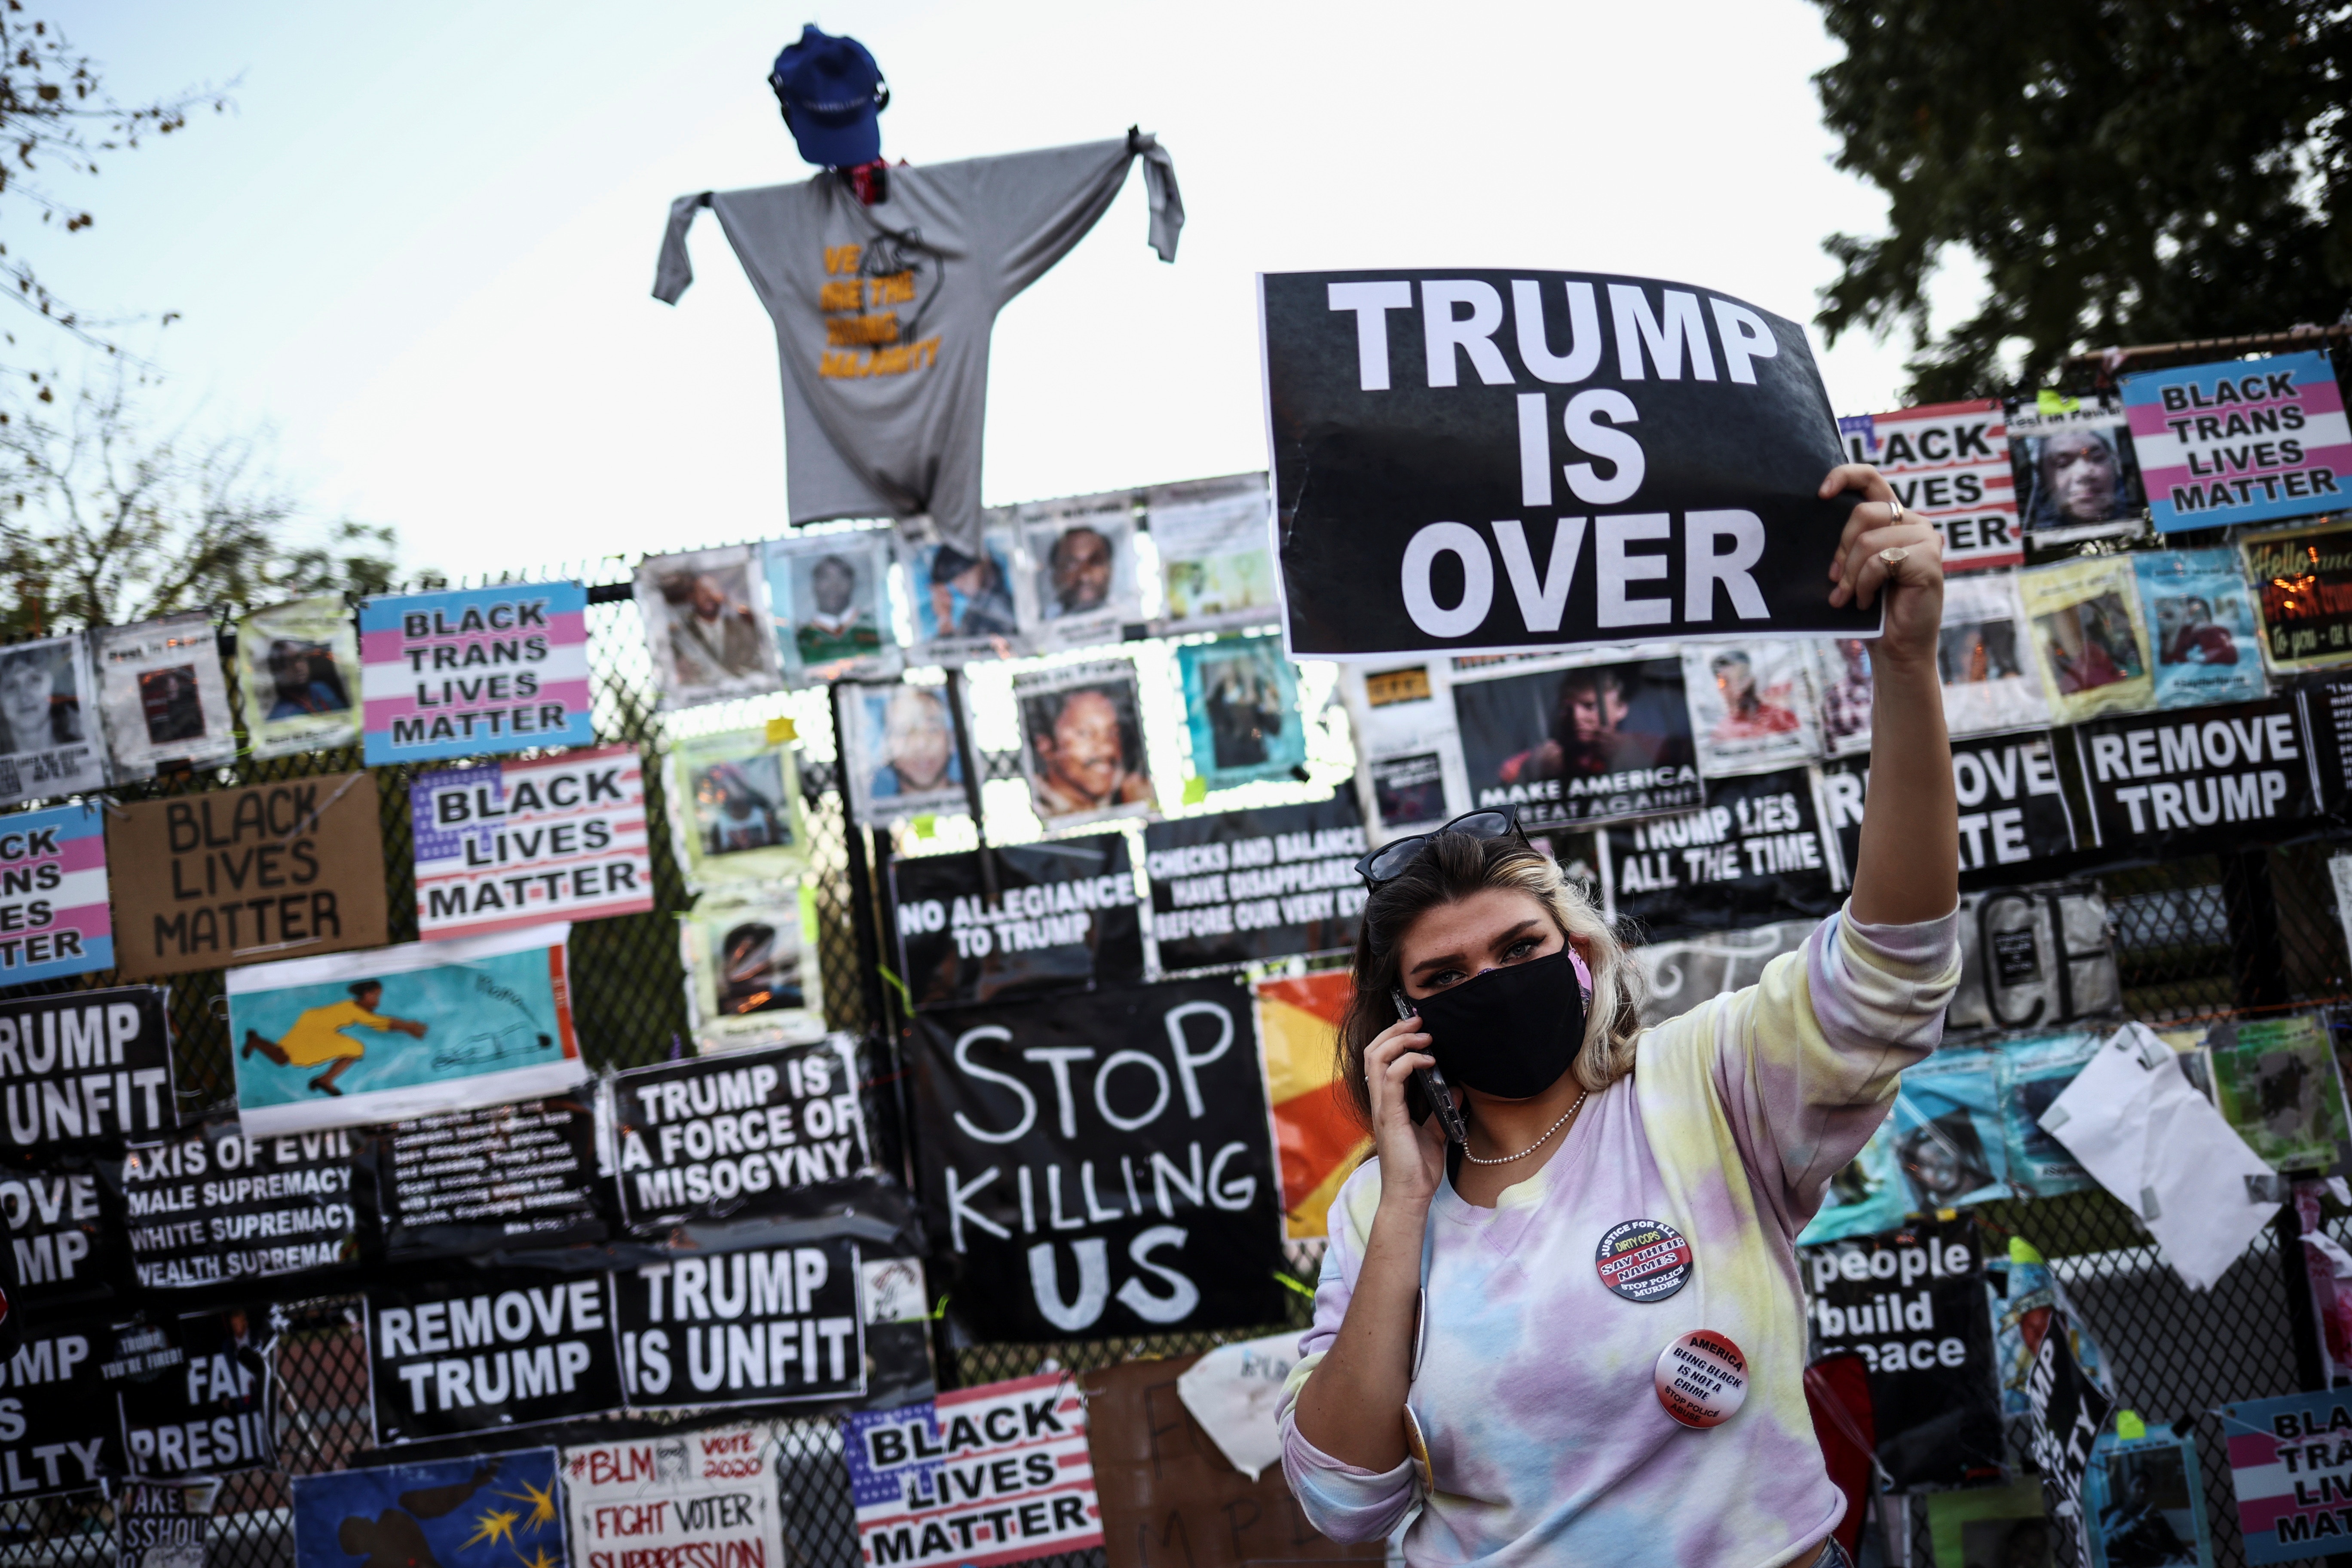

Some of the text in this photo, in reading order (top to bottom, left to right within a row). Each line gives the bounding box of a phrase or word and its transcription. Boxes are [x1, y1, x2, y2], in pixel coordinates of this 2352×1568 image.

[1328, 279, 1777, 391] TRUMP
[2162, 372, 2297, 411] BLACK
[1517, 389, 1645, 506] IS
[1851, 424, 1991, 466] LACK
[2168, 405, 2305, 443] TRANS
[2188, 439, 2303, 476] LIVES
[1893, 473, 1982, 508] VES
[2171, 469, 2337, 511] MATTER
[1401, 509, 1770, 638] OVER
[2252, 542, 2310, 580] Hello
[405, 603, 546, 637] BLACK
[405, 637, 548, 672] TRANS
[418, 671, 538, 707] LIVES
[394, 705, 566, 743] MATTER
[2092, 714, 2298, 783] REMOVE
[438, 770, 622, 823] BLACK
[1479, 763, 1700, 807] MAKE AMERICA
[1825, 745, 2058, 829] ROVE
[2115, 769, 2288, 834] TRUMP
[168, 786, 319, 853] BLACK
[1516, 798, 1580, 824] REAT
[1636, 792, 1800, 851] TRUMP LIES
[466, 821, 610, 866] LIVES
[1148, 842, 1229, 879] CHECKS
[1231, 835, 1274, 869] AND
[1621, 830, 1823, 894] ALL THE TIME
[1957, 808, 2030, 871] TE
[173, 841, 318, 899] LIVES
[430, 863, 638, 918] MATTER
[1171, 856, 1364, 906] HAVE DISAPPEARED
[155, 891, 340, 957] MATTER
[898, 872, 1137, 936] NO ALLEGIANCE
[1155, 885, 1367, 942] BEFORE OUR VERY EY
[0, 931, 83, 967] TER
[952, 912, 1093, 958] TO TRUMP
[0, 1003, 141, 1077] RUMP
[637, 1055, 831, 1125] TRUMP IS
[954, 1001, 1234, 1143] STOP
[6, 1068, 166, 1145] UNFIT
[122, 1130, 351, 1182] AXIS OF EVIL
[622, 1094, 858, 1172] A FORCE OF
[129, 1167, 353, 1217] MALE SUPREMACY
[636, 1139, 853, 1211] MISOGYNY
[945, 1141, 1257, 1254] KILLING
[0, 1176, 100, 1229] OVE
[130, 1204, 356, 1253] WHITE SUPREMACY
[1602, 1224, 1631, 1258] JUSTICE
[1657, 1224, 1675, 1238] ALL
[1615, 1231, 1661, 1252] DIRTY COPS
[137, 1254, 219, 1287] WEALTH
[1028, 1225, 1200, 1331] US
[1601, 1237, 1685, 1275] SAY THEIR
[1617, 1253, 1677, 1282] NAMES
[1621, 1265, 1684, 1290] STOP POLICE
[1812, 1236, 1971, 1292] people
[639, 1248, 829, 1322] TRUMP
[1633, 1278, 1681, 1297] MURDER
[379, 1280, 604, 1359] REMOVE
[1818, 1291, 1934, 1337] build
[400, 1341, 591, 1415] TRUMP
[623, 1317, 854, 1395] IS UNFIT
[1673, 1348, 1743, 1388] BEING BLACK
[1690, 1337, 1743, 1372] AMERICA
[1821, 1337, 1966, 1373] eace
[1665, 1385, 1720, 1417] STOP POLICE
[1674, 1378, 1710, 1401] CRIME
[1677, 1365, 1722, 1393] IS NOT A
[871, 1400, 1063, 1466] BLACK
[1671, 1403, 1701, 1422] ABUSE
[2274, 1406, 2352, 1438] BLA
[8, 1437, 104, 1493] LTY
[131, 1412, 264, 1473] PRESI
[570, 1432, 756, 1486] #BLM VOTE
[2278, 1439, 2352, 1473] TRA
[703, 1458, 762, 1478] 2020
[909, 1453, 1055, 1509] LIVES
[2295, 1475, 2352, 1506] LIV
[134, 1485, 180, 1513] AKE
[595, 1494, 753, 1539] FIGHT VOTER
[126, 1517, 206, 1547] SSHOL
[872, 1496, 1088, 1566] MATTER
[2276, 1508, 2352, 1543] MAT
